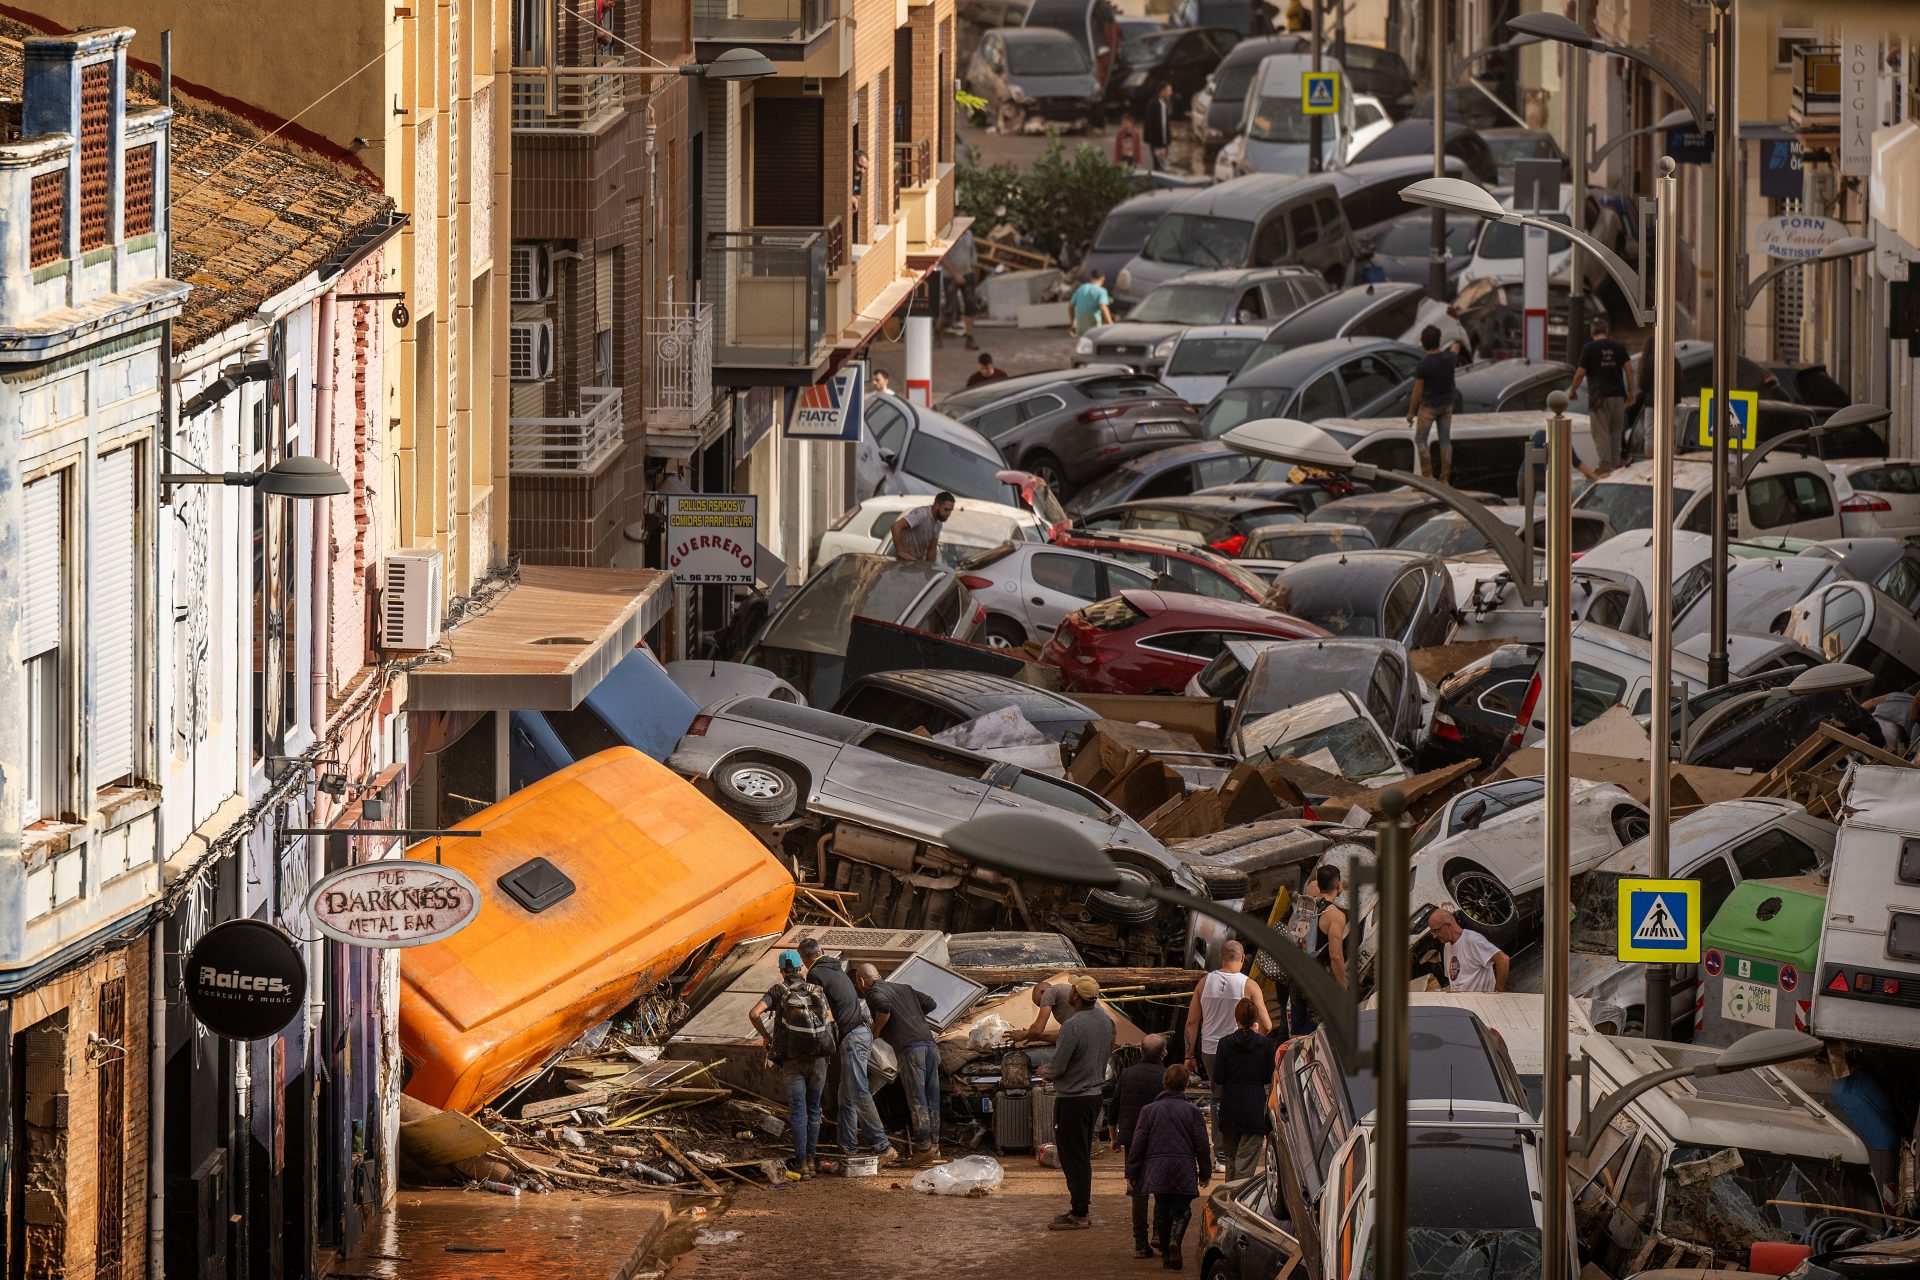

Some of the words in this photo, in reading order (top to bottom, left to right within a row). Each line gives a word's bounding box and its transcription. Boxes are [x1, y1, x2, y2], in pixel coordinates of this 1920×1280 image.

[1780, 218, 1825, 230] FORN
[798, 410, 839, 422] FIATC
[679, 499, 707, 512] POLLOS
[708, 500, 738, 512] ASADOS
[737, 500, 745, 512] Y
[670, 514, 703, 527] COMIDAS
[704, 515, 724, 527] PARA
[725, 515, 754, 527] LLEVAR
[670, 535, 753, 569] GUERRERO
[378, 870, 406, 887] PUB
[325, 885, 461, 915] DARKNESS
[349, 915, 399, 934] METAL
[404, 914, 436, 931] BAR
[202, 966, 284, 992] Raices
[198, 988, 241, 1000] cocktail
[247, 994, 254, 1002] &
[1749, 985, 1771, 995] ALFAFAR
[1755, 1003, 1771, 1012] TOTS
